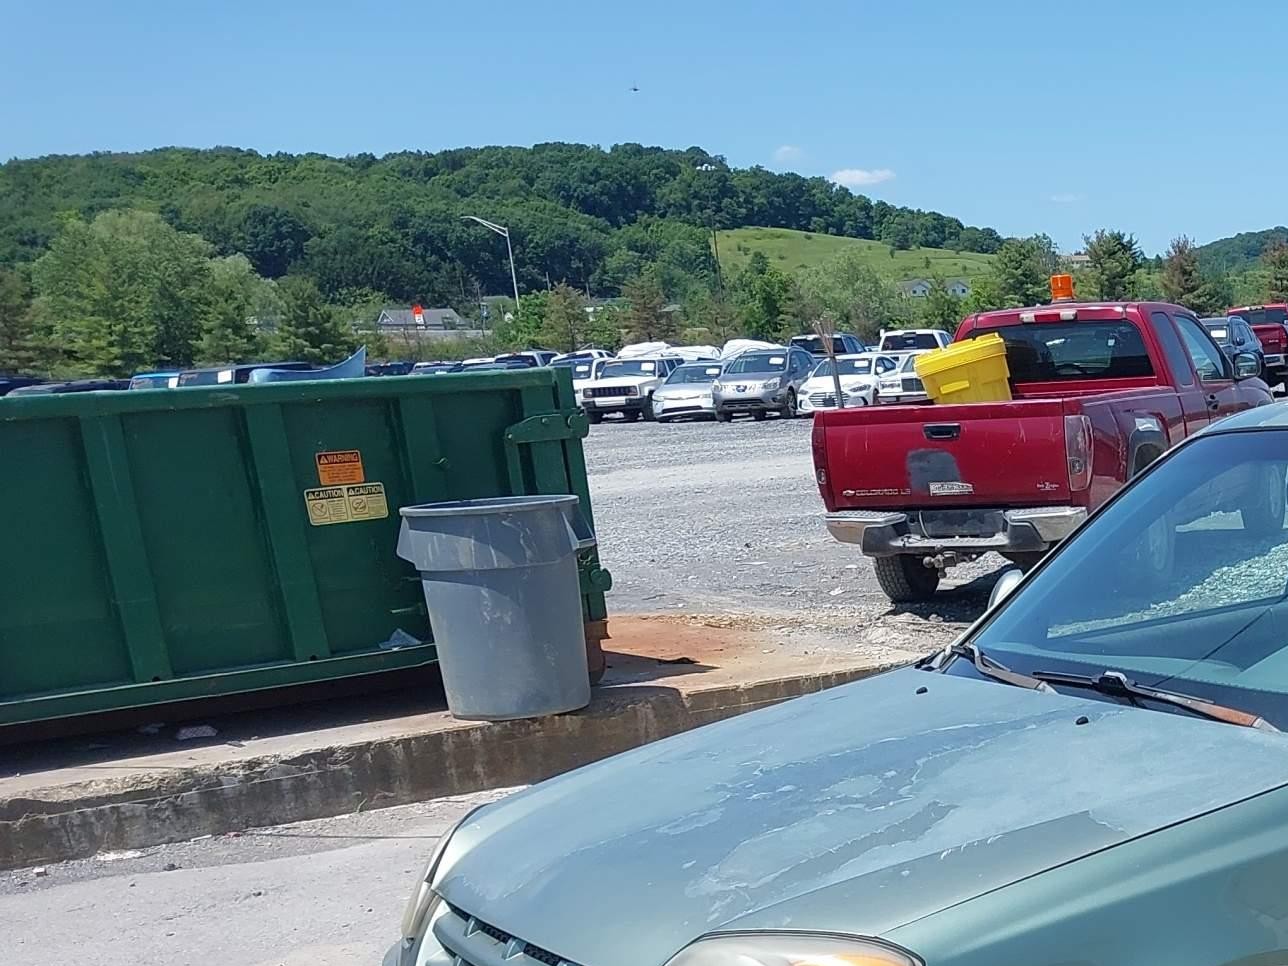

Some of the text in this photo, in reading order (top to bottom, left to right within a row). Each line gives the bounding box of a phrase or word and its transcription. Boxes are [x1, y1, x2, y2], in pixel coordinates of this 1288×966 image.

[326, 453, 358, 464] WARNING
[314, 489, 344, 499] CAUTION
[354, 486, 383, 496] CAUTION
